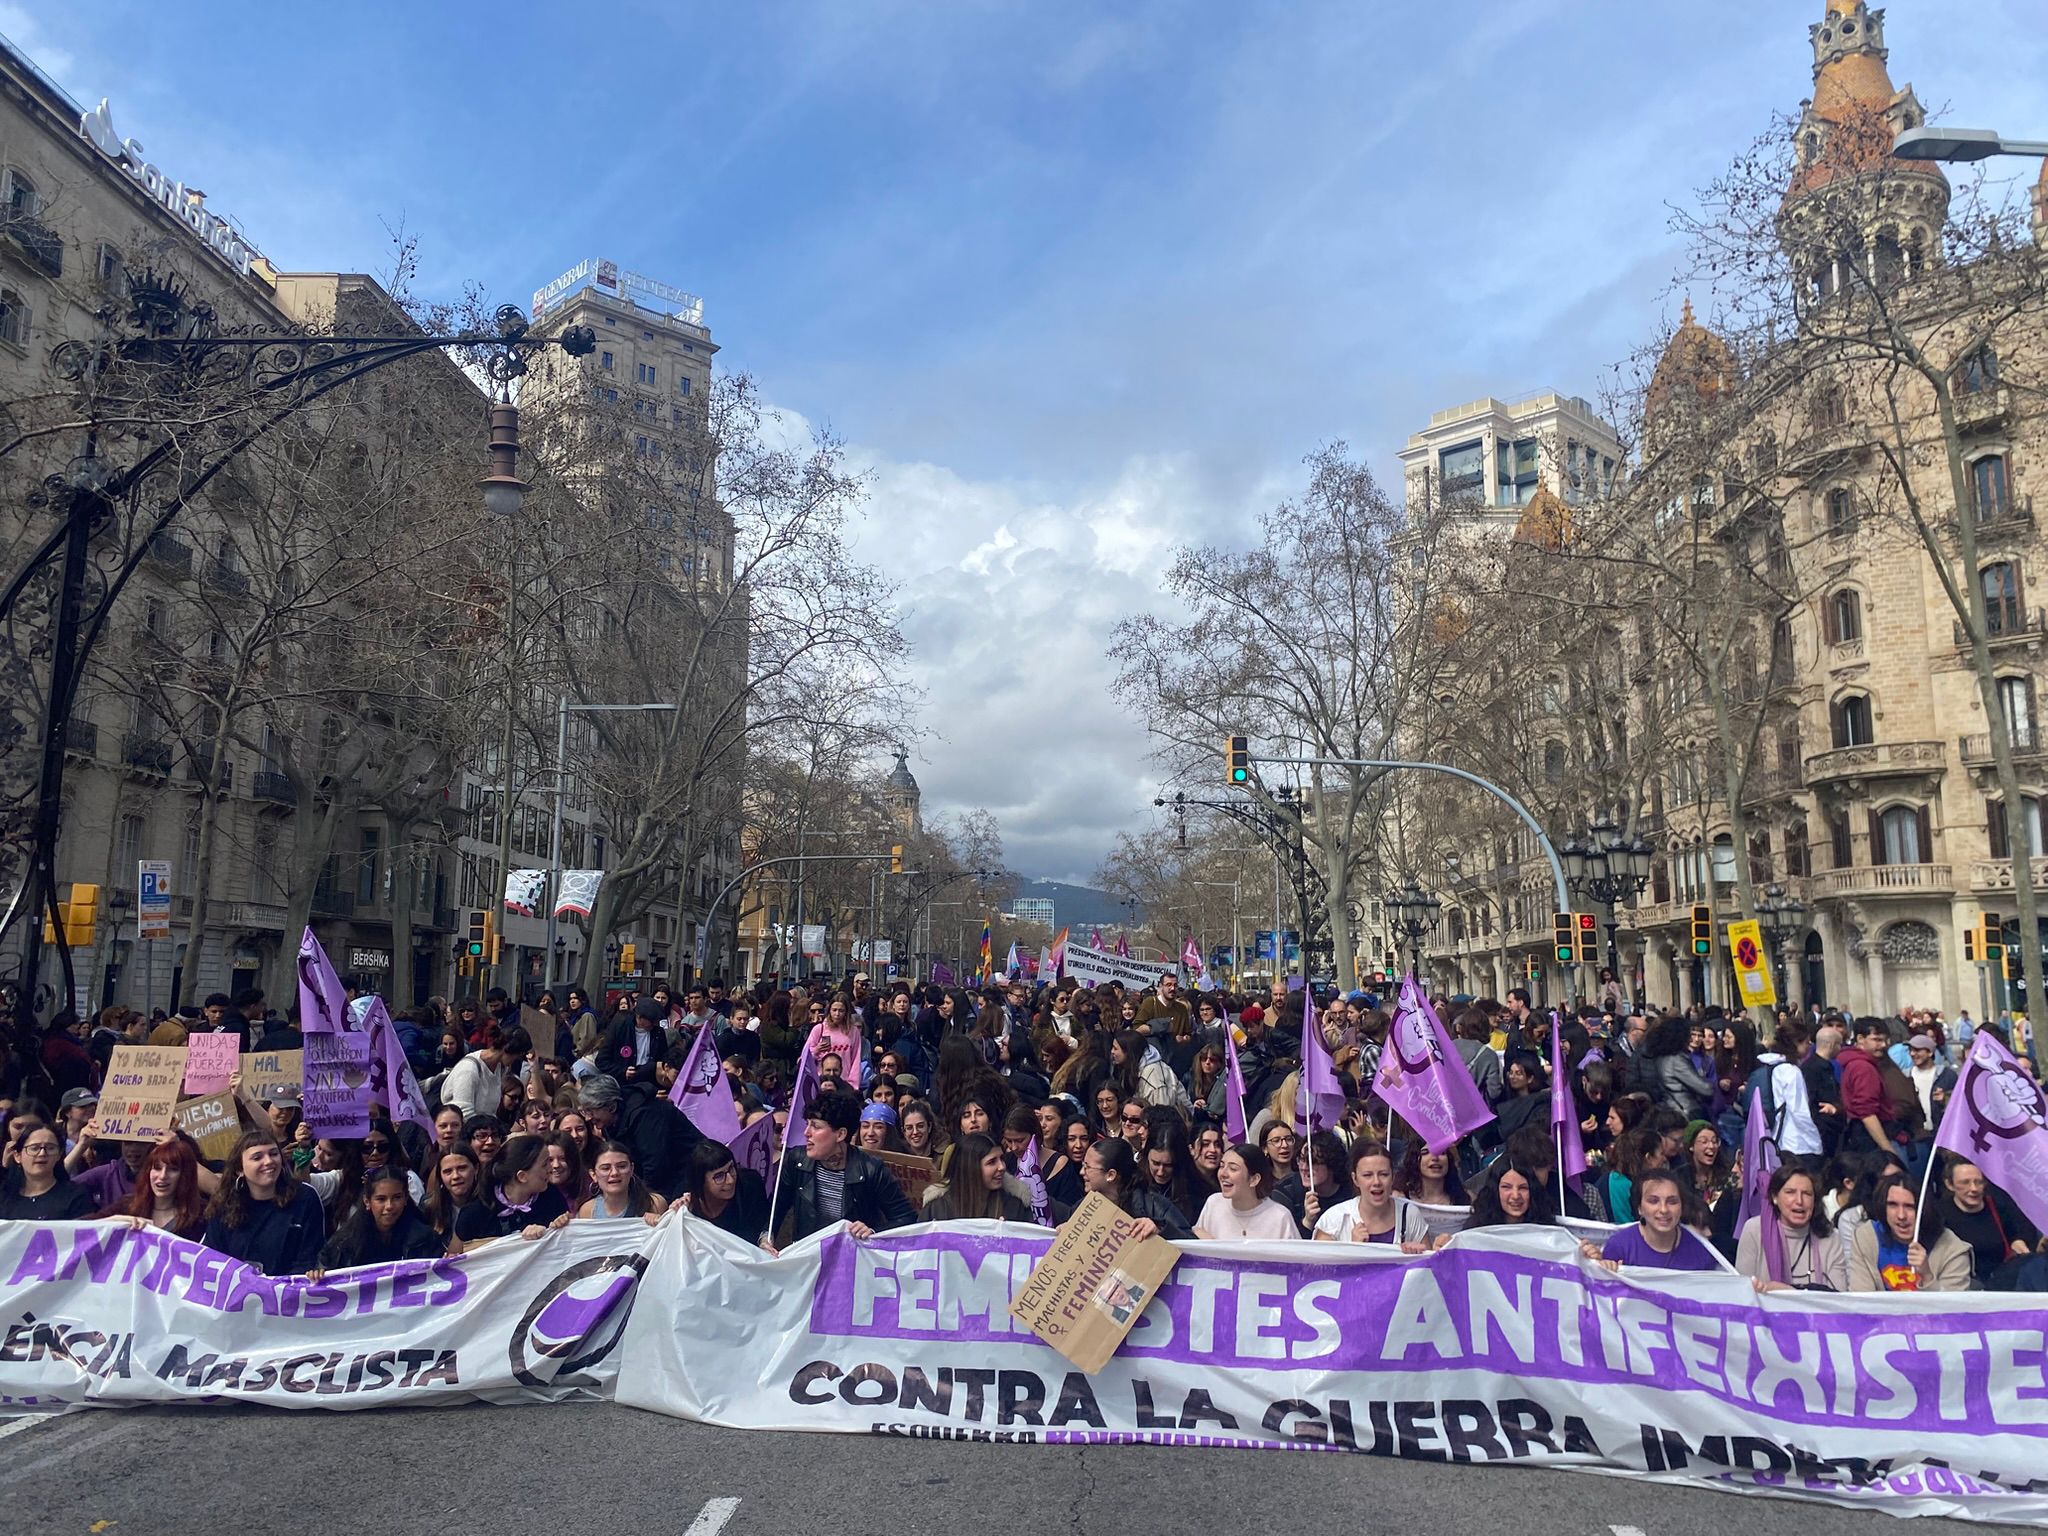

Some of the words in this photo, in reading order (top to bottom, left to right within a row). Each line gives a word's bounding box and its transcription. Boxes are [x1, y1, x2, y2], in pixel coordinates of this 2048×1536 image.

[122, 138, 251, 276] Santander
[145, 875, 153, 893] P
[353, 953, 389, 967] BERSHKA
[889, 965, 896, 974] P
[189, 1034, 238, 1049] UNIDAS
[187, 1058, 233, 1070] FUERZA
[253, 1055, 283, 1072] MAL
[128, 1103, 139, 1115] NO
[1014, 1263, 1057, 1320] MENOS
[1053, 1196, 1103, 1263] PRESIDENTES
[6, 1228, 468, 1318] ANTIFEIXISTES
[1034, 1269, 1077, 1331] MACHISTAS
[1075, 1254, 1085, 1265] Y
[1087, 1223, 1106, 1249] MÁS
[154, 1344, 459, 1394] MASCLISTA
[788, 1360, 1106, 1429] CONTRA
[1131, 1378, 1239, 1430] LA
[1261, 1398, 1602, 1462] GUERRA
